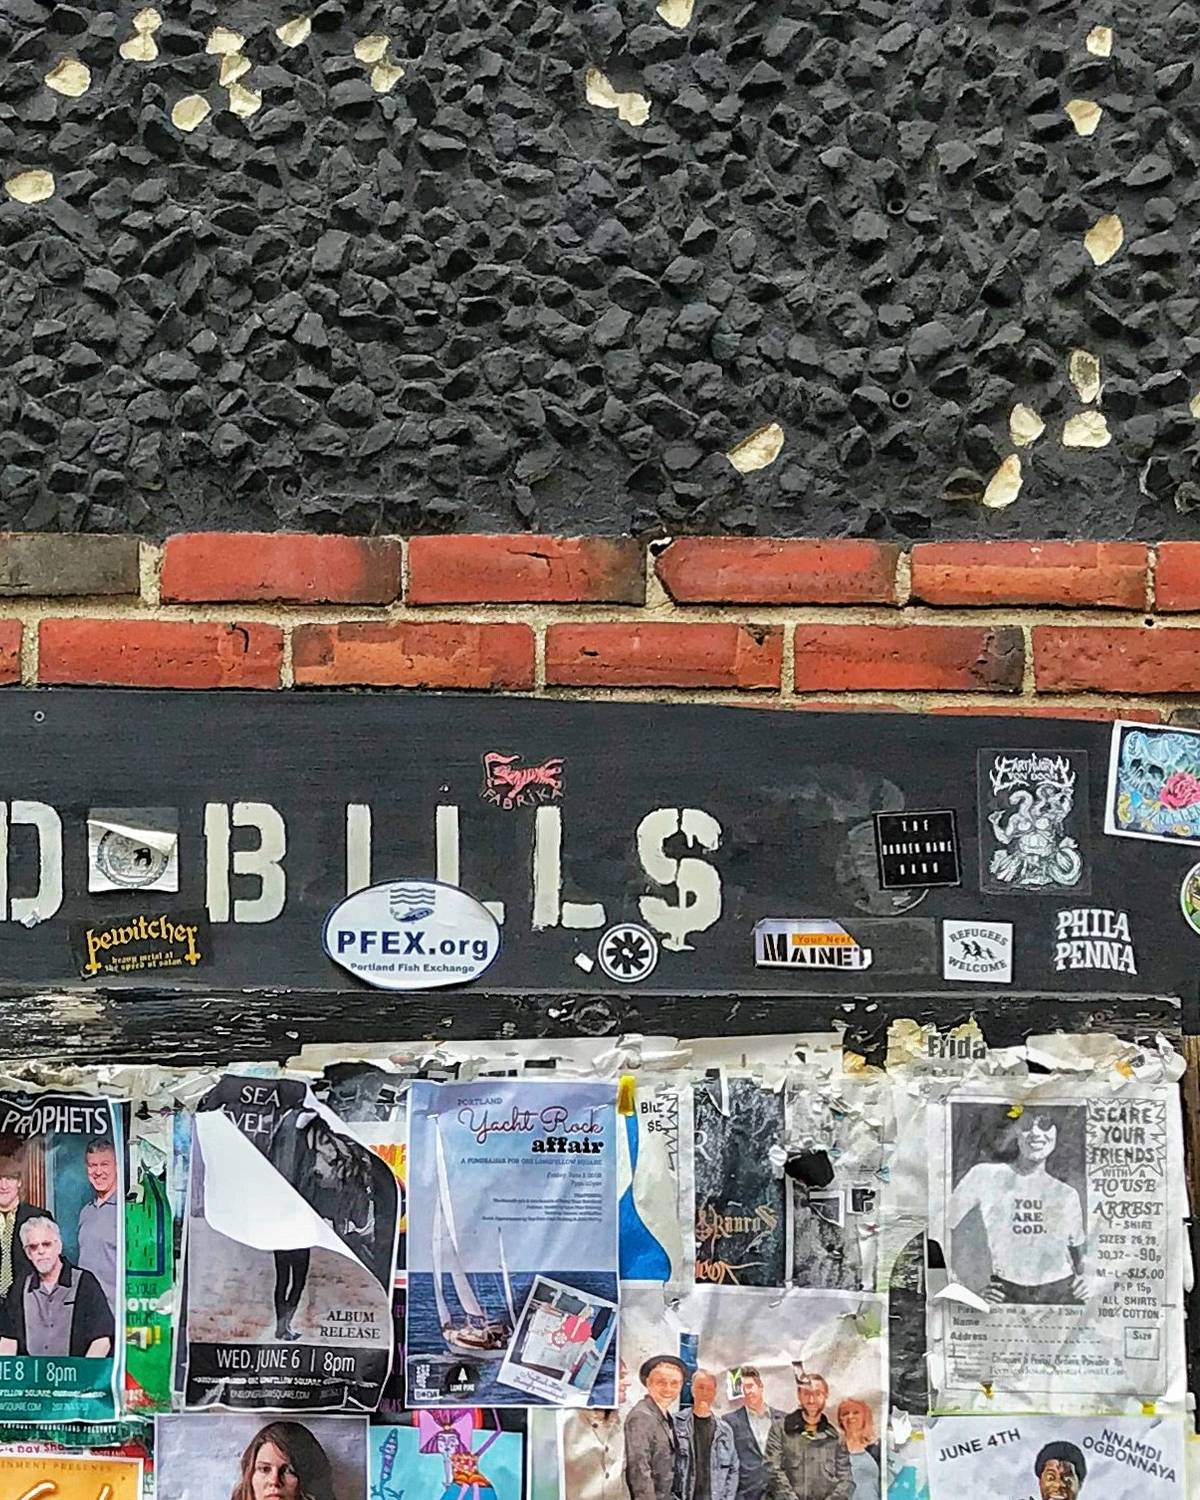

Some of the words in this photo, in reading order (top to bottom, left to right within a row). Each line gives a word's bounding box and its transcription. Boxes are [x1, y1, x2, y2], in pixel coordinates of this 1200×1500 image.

[1055, 908, 1129, 941] PHILA
[85, 915, 201, 966] bewitcher
[337, 931, 489, 961] PFEX.org
[949, 928, 1007, 946] REFUGEES
[948, 955, 1007, 973] WELCOME
[1053, 938, 1139, 975] PENNA
[351, 963, 394, 974] Portland
[398, 963, 420, 974] Fish
[423, 963, 475, 974] Exchange
[240, 1086, 280, 1104] SEA
[0, 1108, 108, 1138] PROPHETS
[458, 1106, 535, 1143] Yacht
[541, 1106, 604, 1134] Rock
[1094, 1107, 1152, 1124] SCARE
[1100, 1126, 1145, 1144] YOUR
[531, 1136, 604, 1154] affair
[1091, 1147, 1155, 1164] FRIENDS
[1013, 1199, 1043, 1210] YOU
[1013, 1212, 1042, 1222] ARE
[1012, 1225, 1047, 1235] GOD.
[327, 1310, 375, 1324] ALBUM
[320, 1325, 380, 1339] RELEASE
[938, 1438, 984, 1462] JUNE
[987, 1427, 1021, 1447] 4TH
[1101, 1429, 1162, 1462] NNAMDI
[1083, 1436, 1176, 1482] OGBONNAYA
